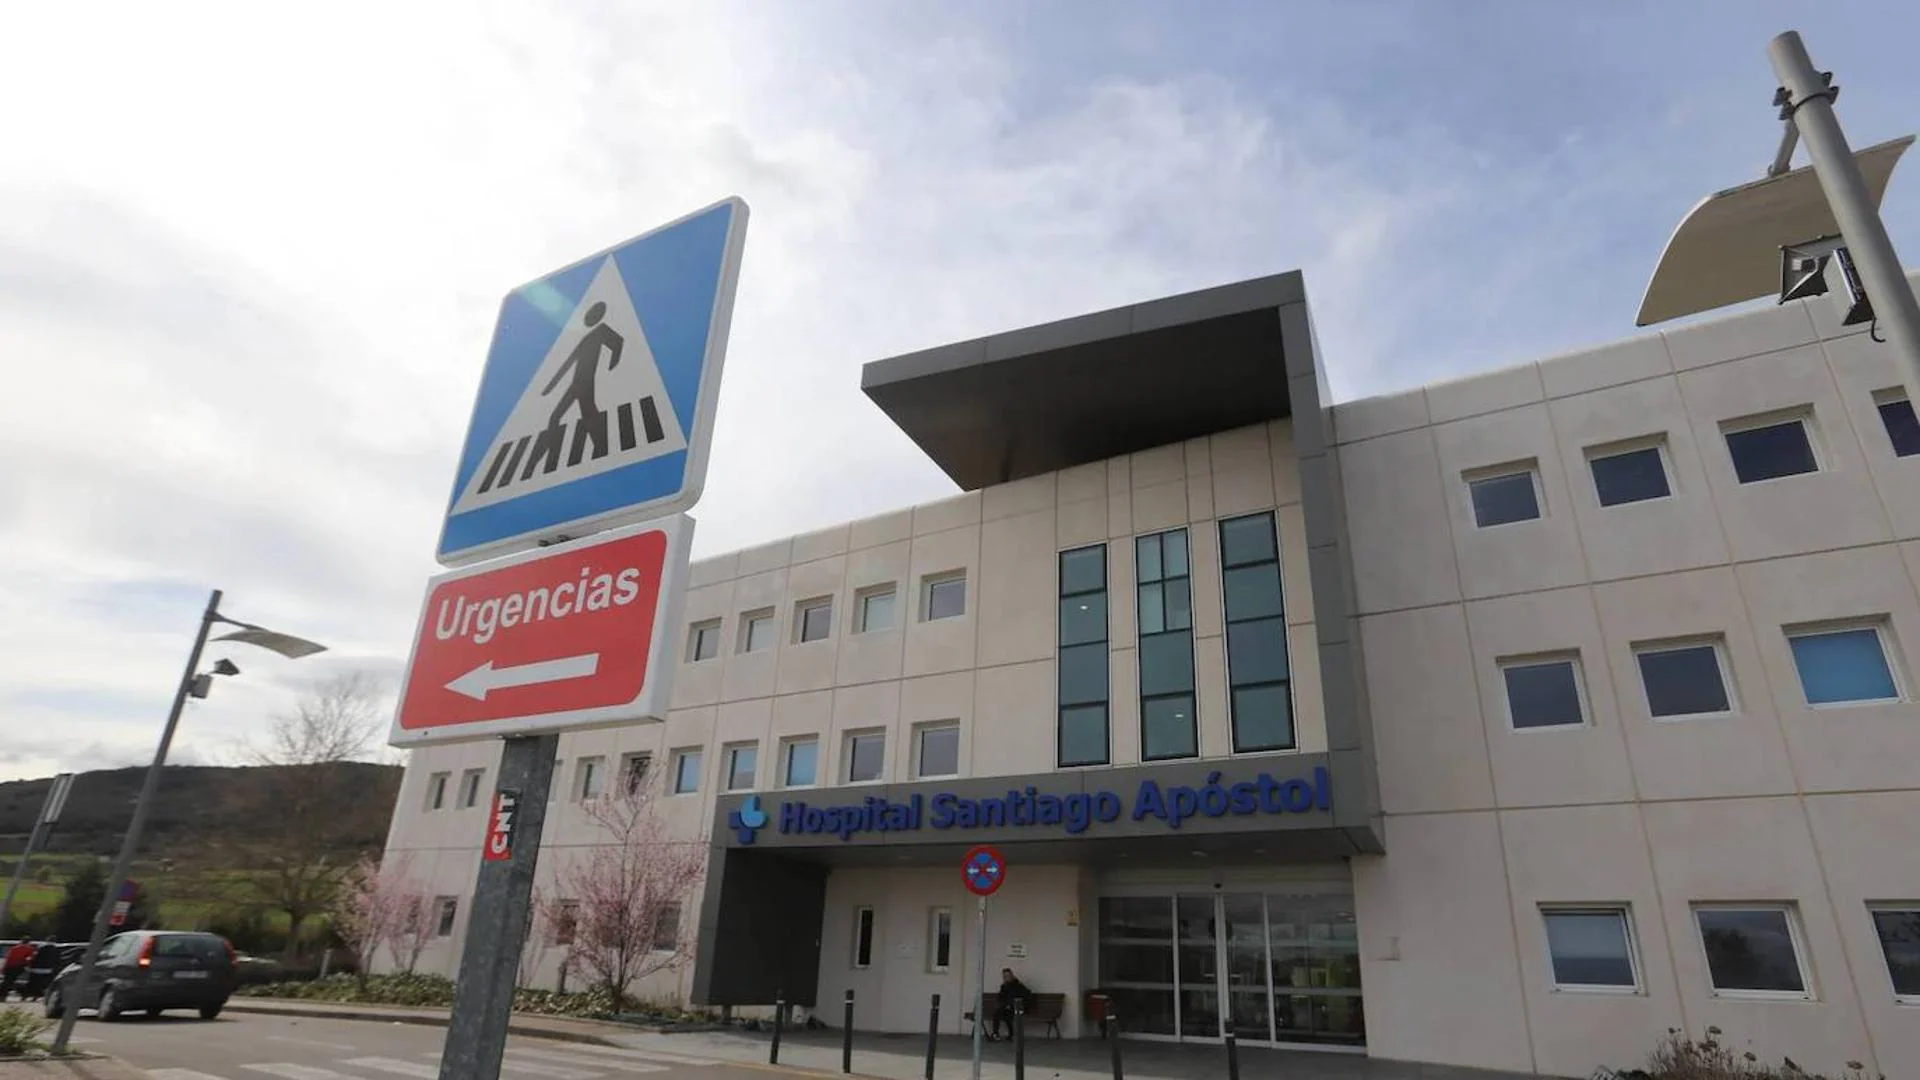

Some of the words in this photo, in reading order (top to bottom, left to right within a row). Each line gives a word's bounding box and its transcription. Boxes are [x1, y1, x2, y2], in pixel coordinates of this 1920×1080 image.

[435, 566, 640, 644] Urgencias
[491, 793, 515, 854] CNT
[780, 793, 922, 841] Hospital
[930, 785, 1122, 833] Santiago
[1131, 766, 1331, 829] Apóstol
